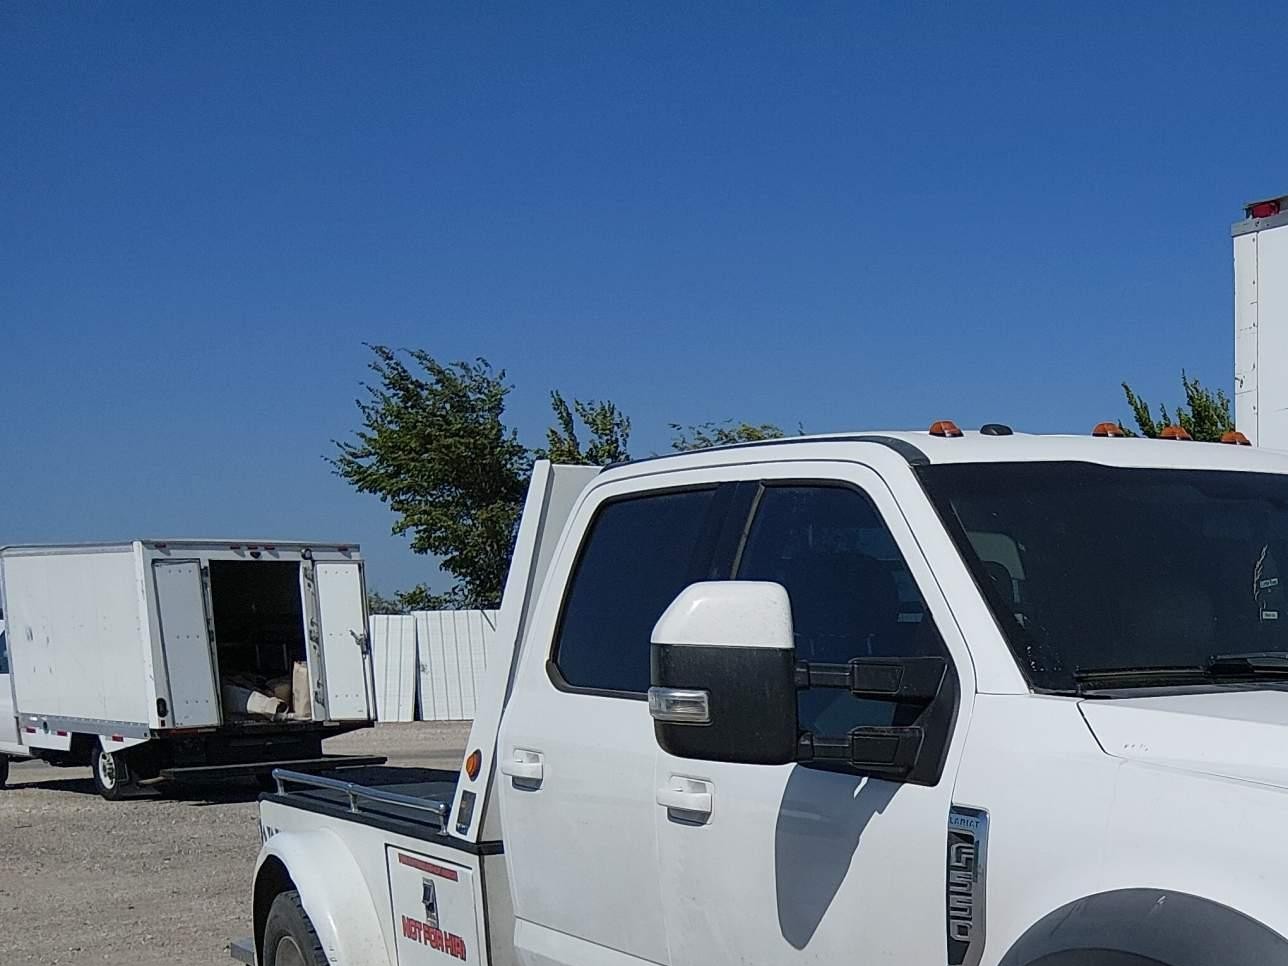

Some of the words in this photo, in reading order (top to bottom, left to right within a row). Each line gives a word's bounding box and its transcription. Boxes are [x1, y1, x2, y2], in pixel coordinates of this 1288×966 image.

[948, 814, 981, 829] LARIAT
[401, 914, 423, 944] NOT
[422, 923, 445, 953] FOR
